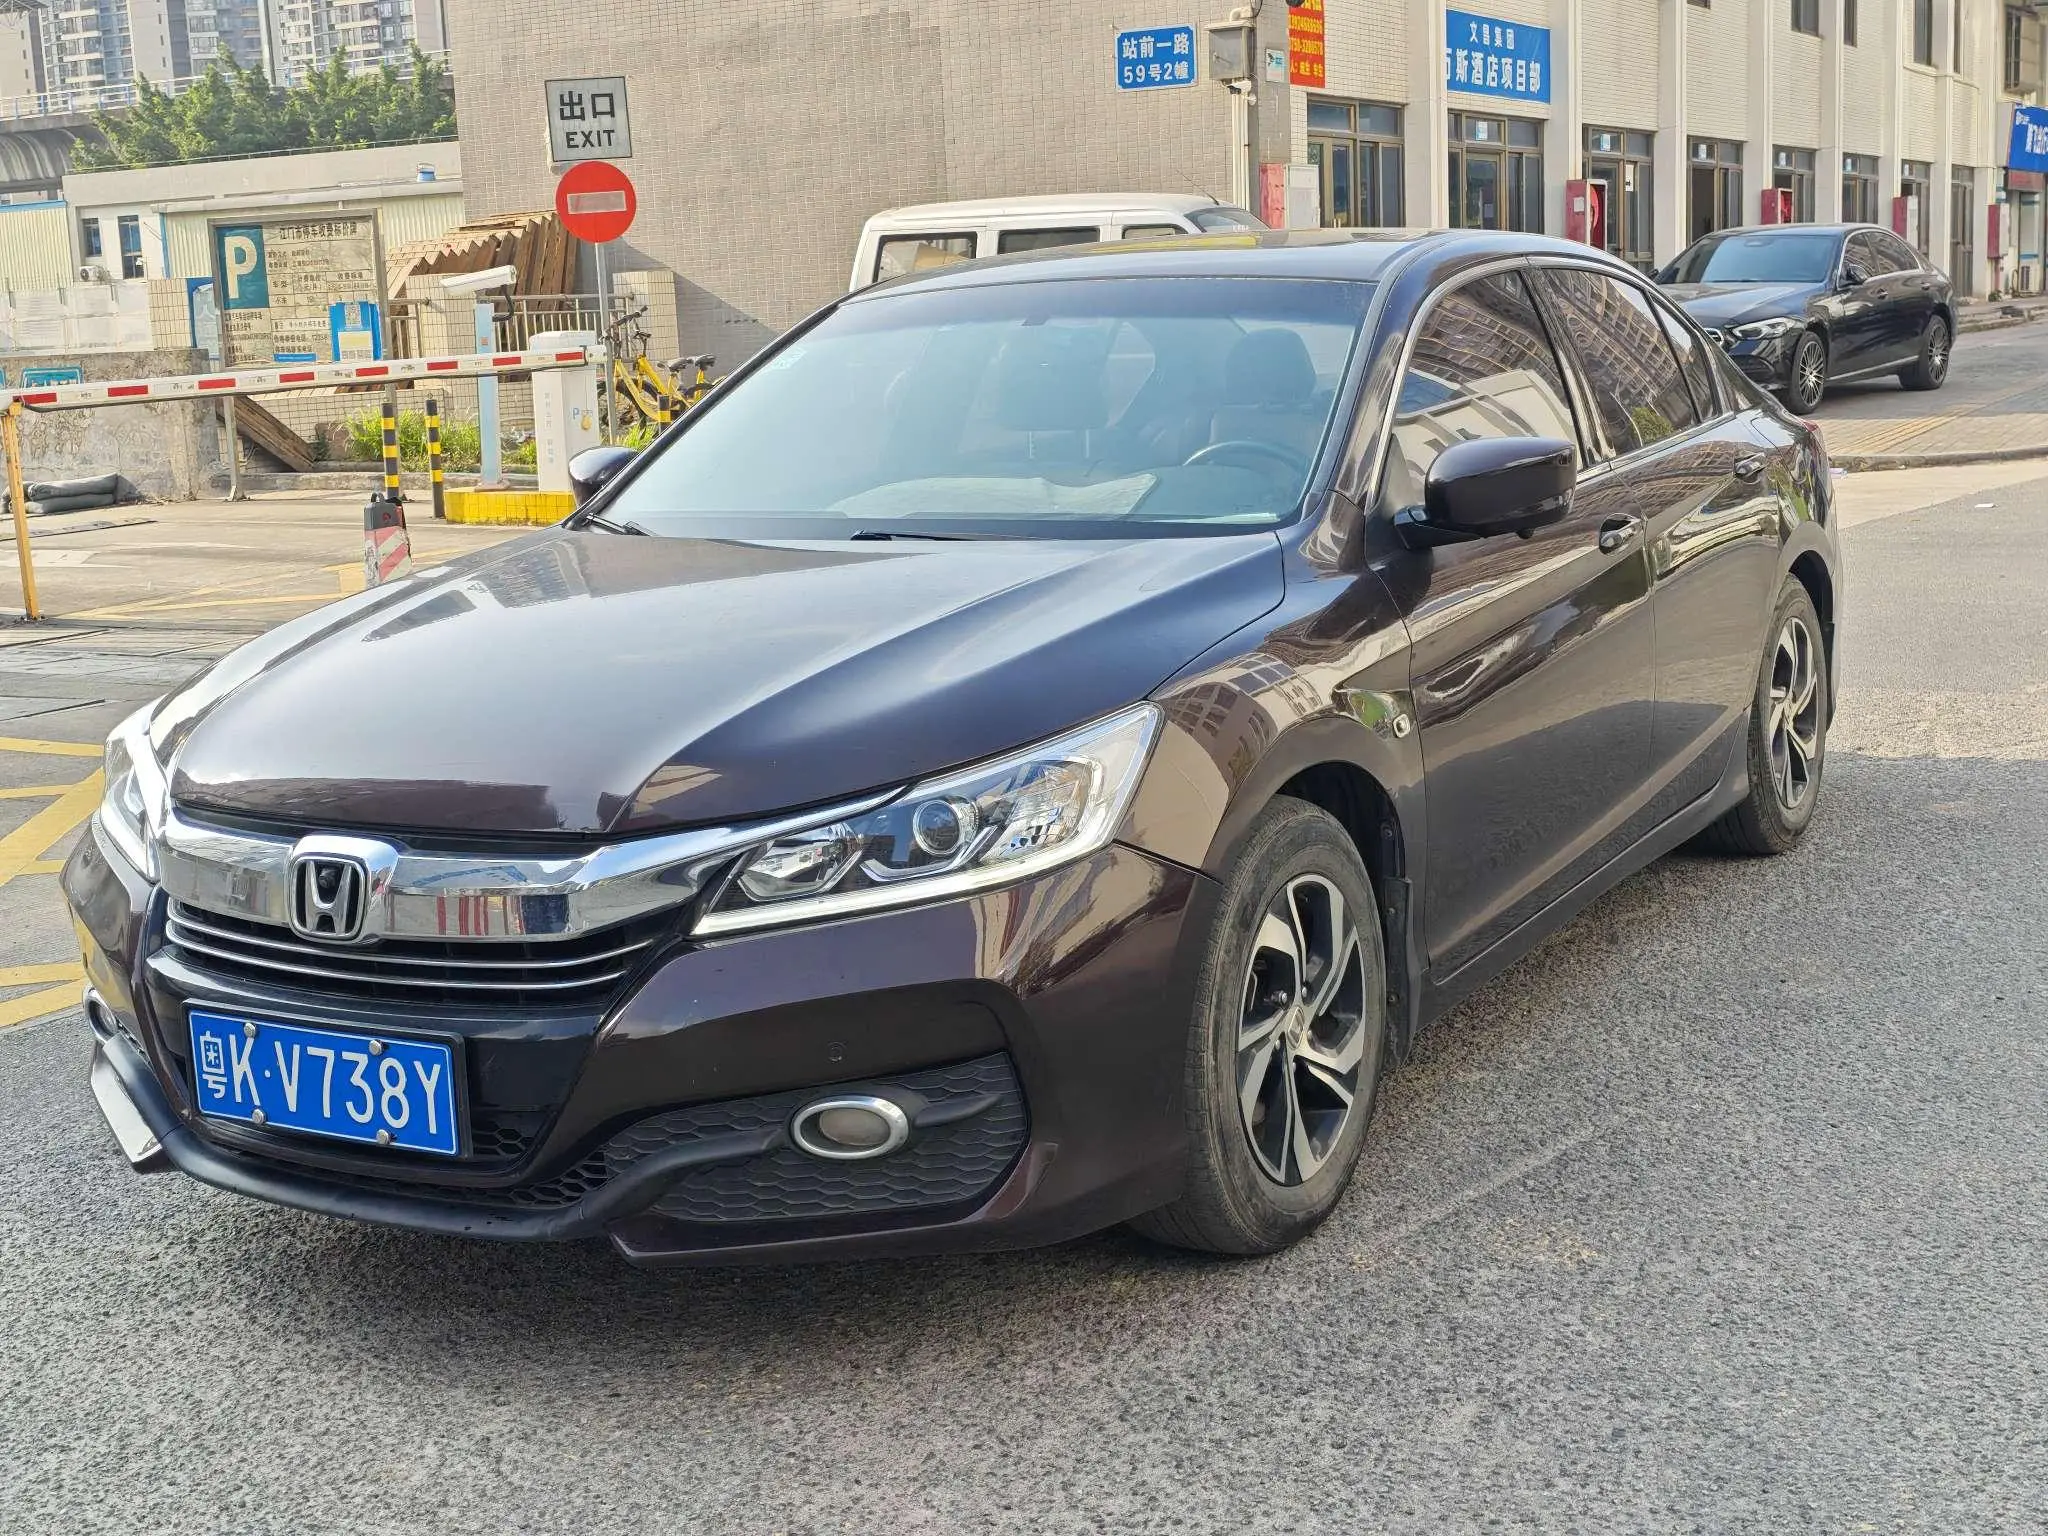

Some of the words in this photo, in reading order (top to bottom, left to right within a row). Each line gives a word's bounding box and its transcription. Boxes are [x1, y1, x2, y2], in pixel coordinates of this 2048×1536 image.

[1122, 32, 1189, 59] 站前一路
[1469, 21, 1515, 50] 文昌集团
[1124, 61, 1189, 83] 59号2幢
[559, 90, 616, 121] 出口
[565, 129, 616, 149] EXIT
[279, 221, 357, 240] 江门市停车收费标价牌
[224, 235, 258, 299] P
[199, 1029, 442, 1135] 粤K·V738Y
